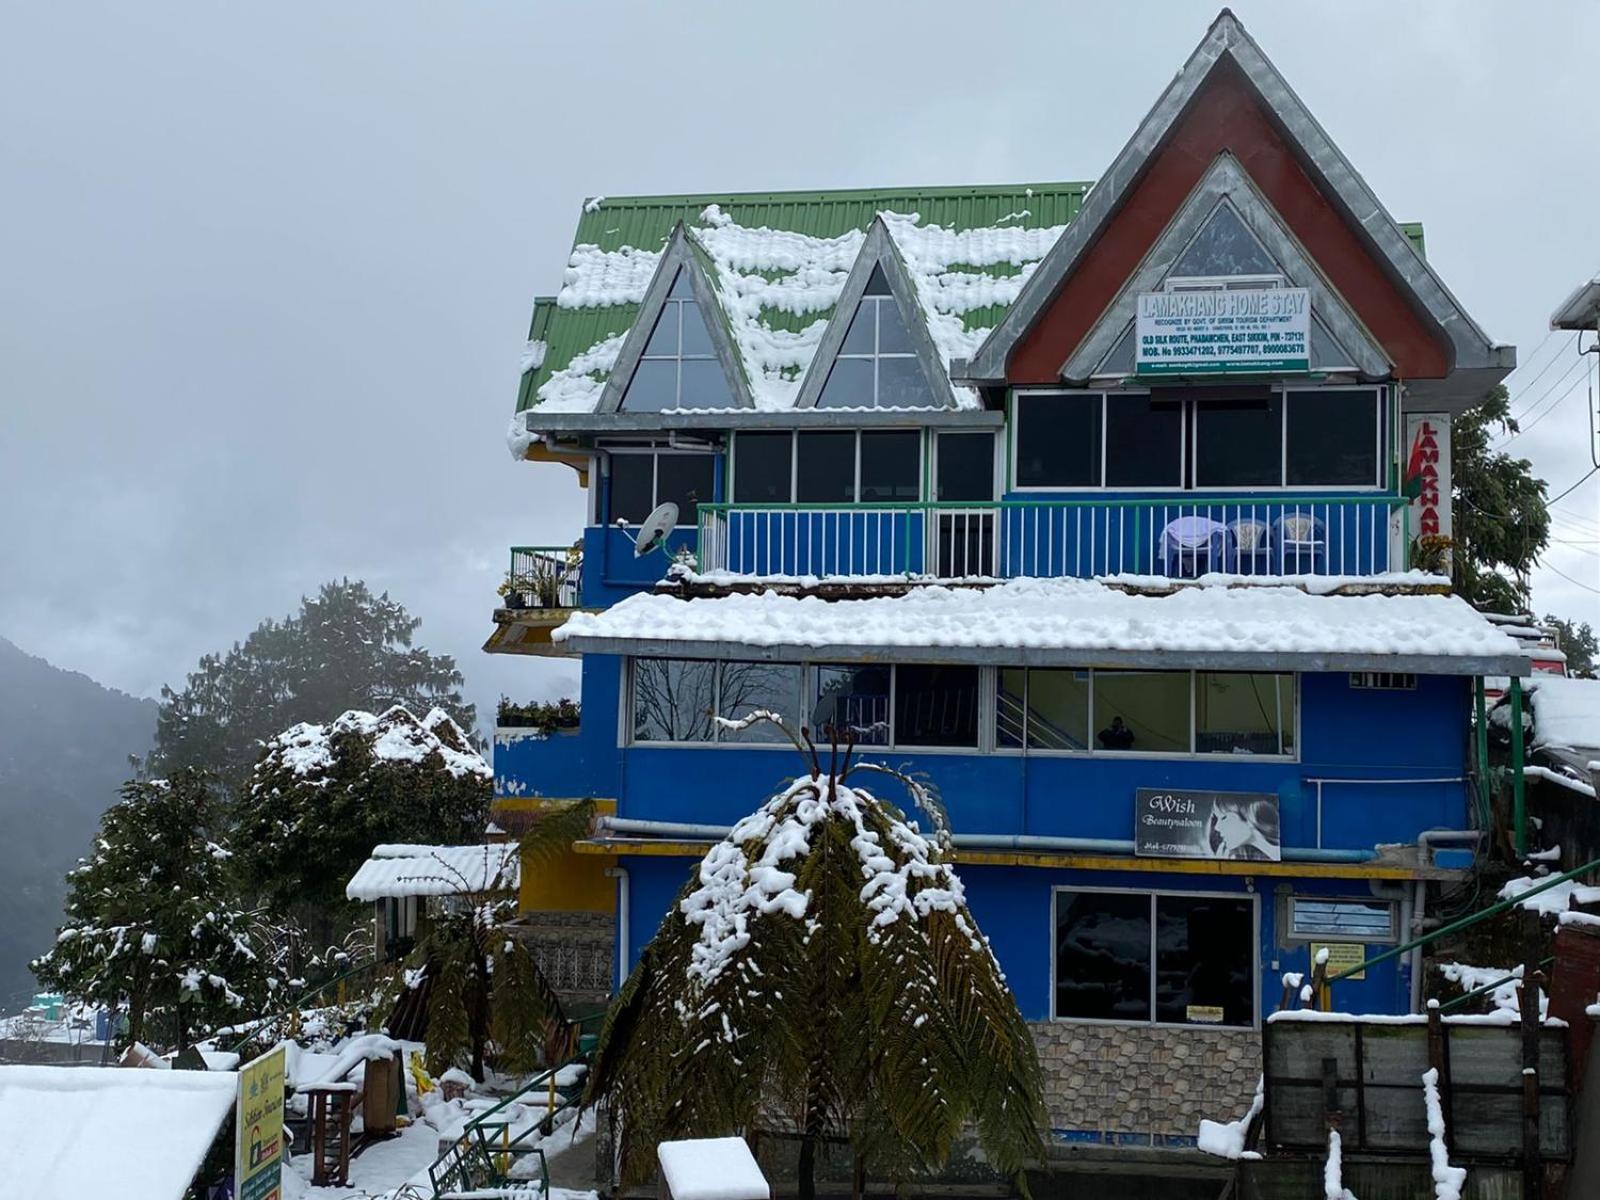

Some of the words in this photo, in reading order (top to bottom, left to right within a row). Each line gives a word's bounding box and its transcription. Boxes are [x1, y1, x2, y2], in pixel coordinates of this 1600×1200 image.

[1143, 295, 1226, 318] LAMAKHANG
[1231, 293, 1268, 316] HOME
[1272, 292, 1305, 315] STAY
[1209, 317, 1215, 325] OF
[1235, 316, 1258, 324] TOURISM
[1259, 315, 1292, 323] DEPARTMENT
[1142, 335, 1154, 345] OLD
[1155, 335, 1168, 345] SILK
[1168, 335, 1189, 346] ROUTE,
[1231, 333, 1246, 343] EAST
[1270, 332, 1281, 342] PIN
[1149, 794, 1196, 814] Wish
